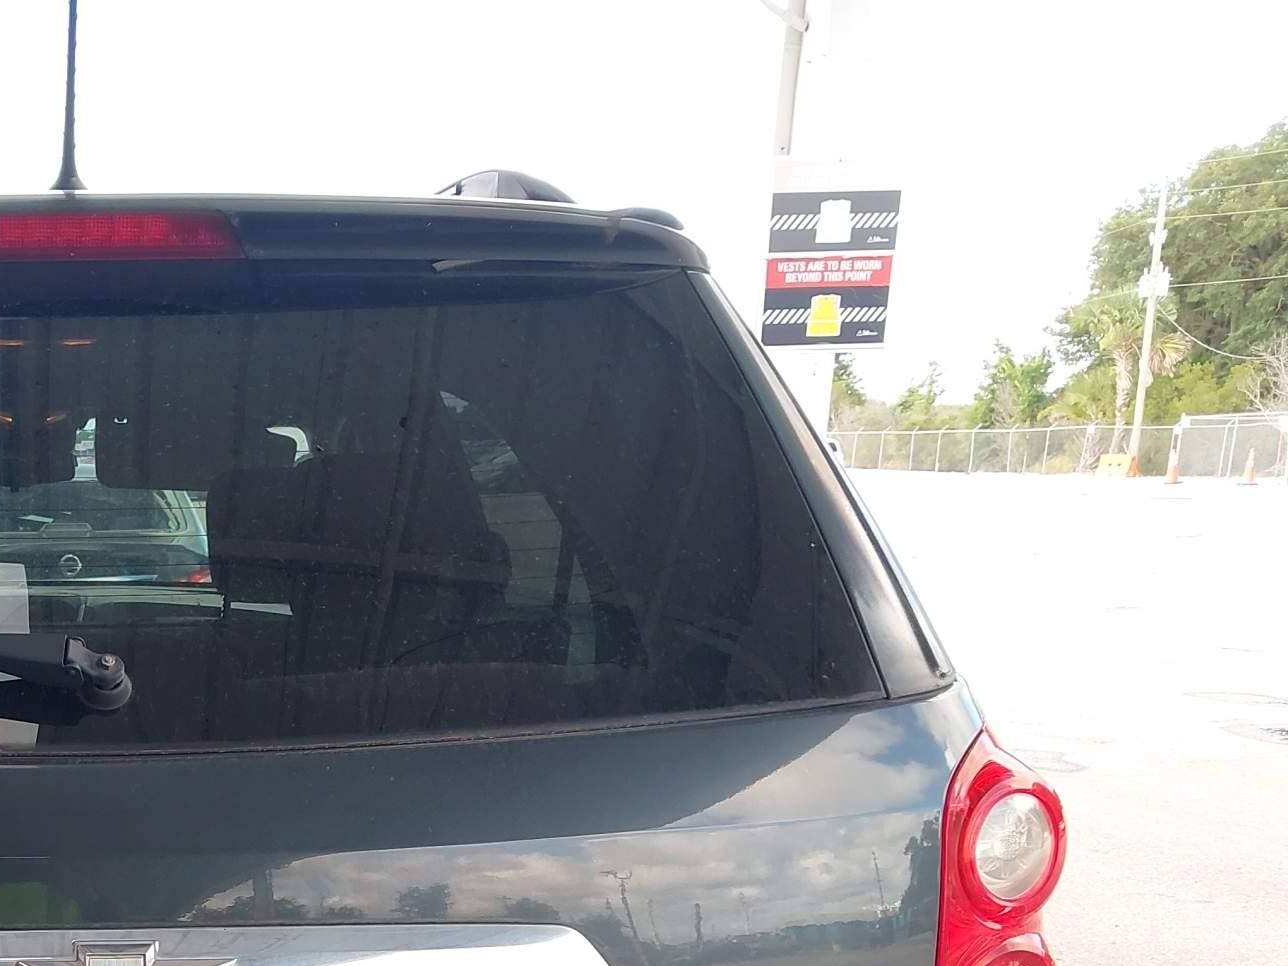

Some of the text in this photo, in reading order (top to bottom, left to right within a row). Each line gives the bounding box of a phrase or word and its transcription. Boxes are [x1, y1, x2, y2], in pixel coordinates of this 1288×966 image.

[777, 260, 882, 272] VESTS ARE TO BE WORN
[785, 271, 872, 283] BEYOND THIS POINT
